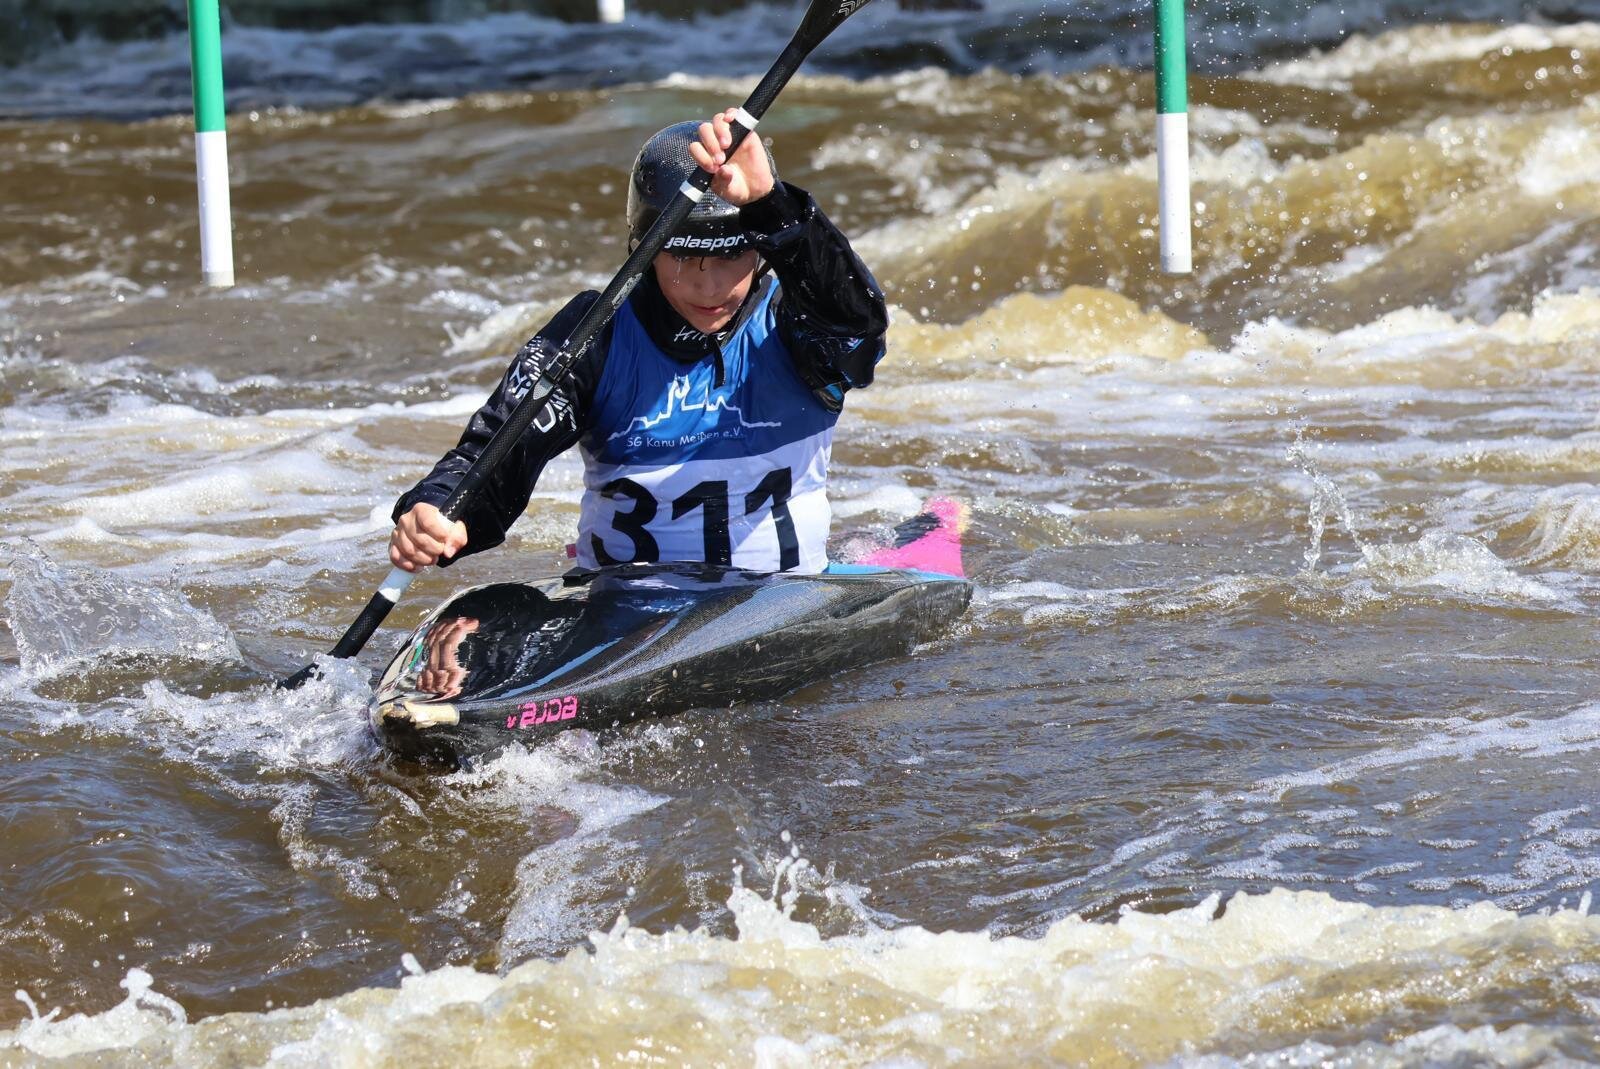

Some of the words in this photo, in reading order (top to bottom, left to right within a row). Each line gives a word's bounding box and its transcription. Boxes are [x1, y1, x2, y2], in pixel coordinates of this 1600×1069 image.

[664, 234, 748, 251] alaspor
[626, 436, 642, 447] SG
[646, 437, 675, 448] Kanu
[591, 466, 800, 571] 311
